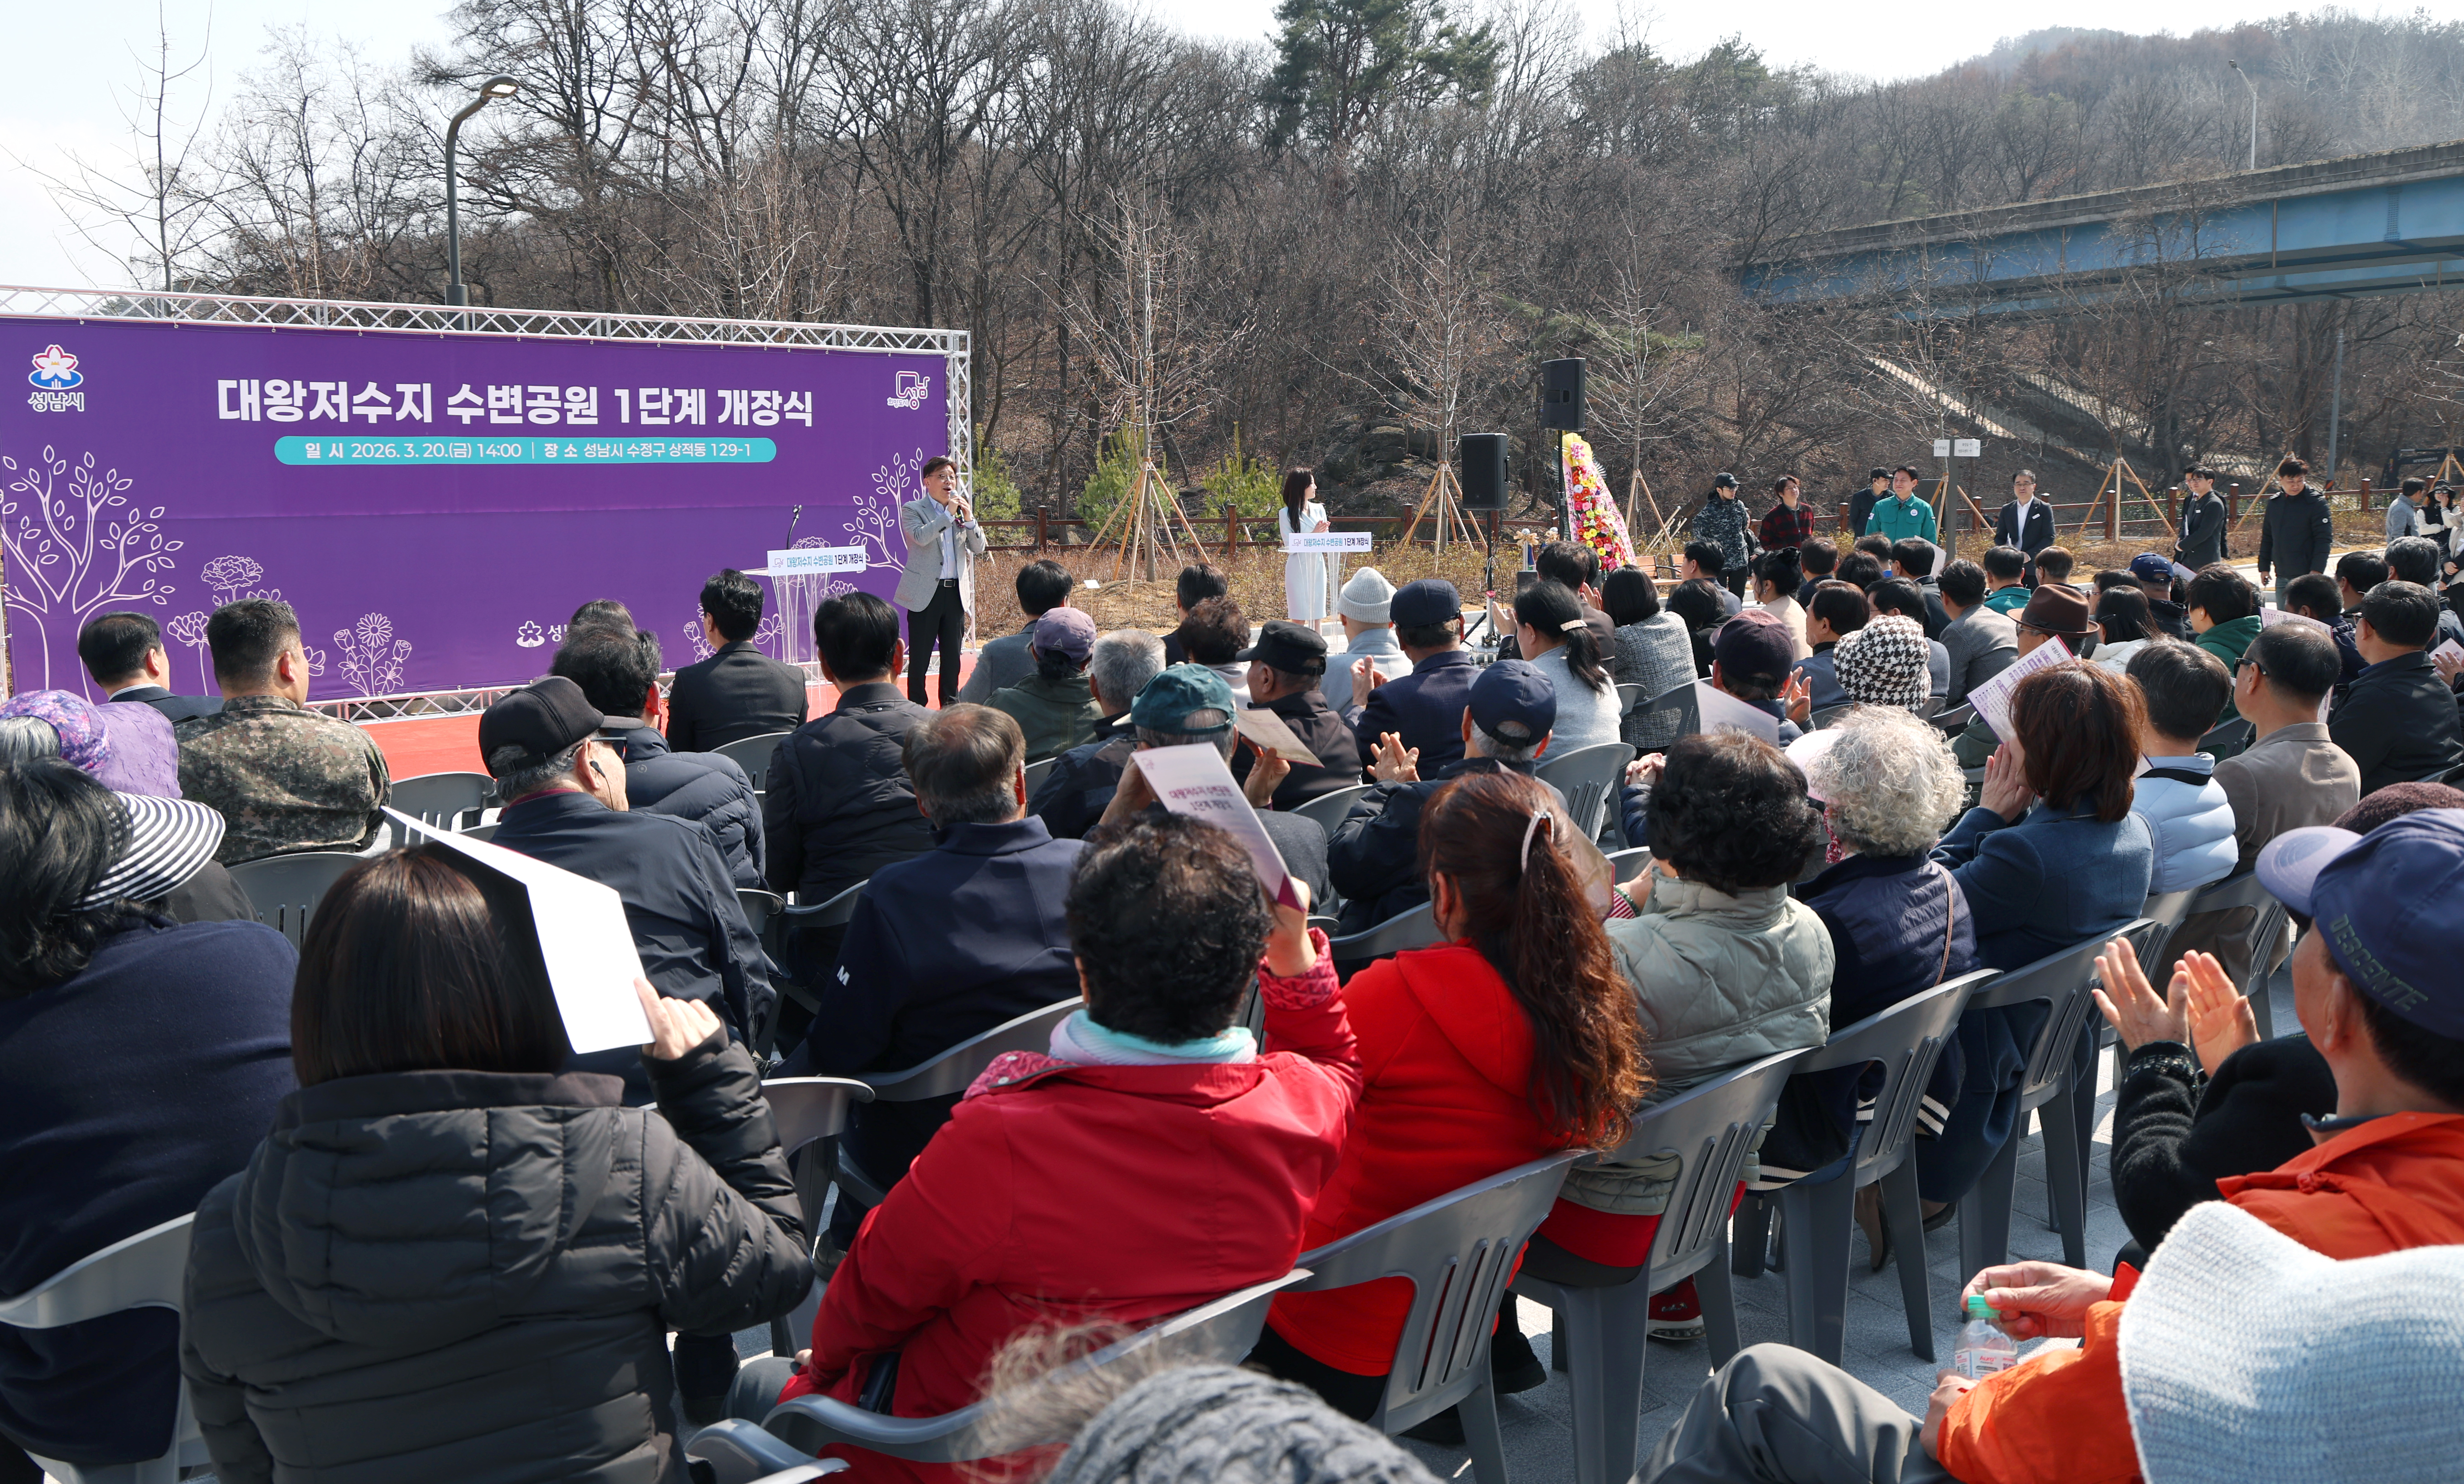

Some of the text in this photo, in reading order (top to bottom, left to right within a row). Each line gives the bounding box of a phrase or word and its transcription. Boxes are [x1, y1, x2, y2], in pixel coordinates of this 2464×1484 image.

[27, 392, 85, 412] 성남시
[218, 379, 812, 427] 대왕저수지 수변공원 1단계 개장식
[887, 397, 909, 408] 희망도시
[351, 443, 400, 458] 2026.
[404, 443, 419, 458] 3.
[477, 443, 521, 457] 14:00
[584, 443, 622, 458] 성남시
[627, 443, 665, 458] 수정구
[669, 443, 706, 457] 상적동
[711, 443, 750, 456] 129-1
[1304, 537, 1369, 547] 대왕저수지 수변공원 1단계 개장식
[787, 553, 863, 568] 대왕저수지 수변공원 1단계 개장식
[2330, 913, 2428, 1012] DESCENTE
